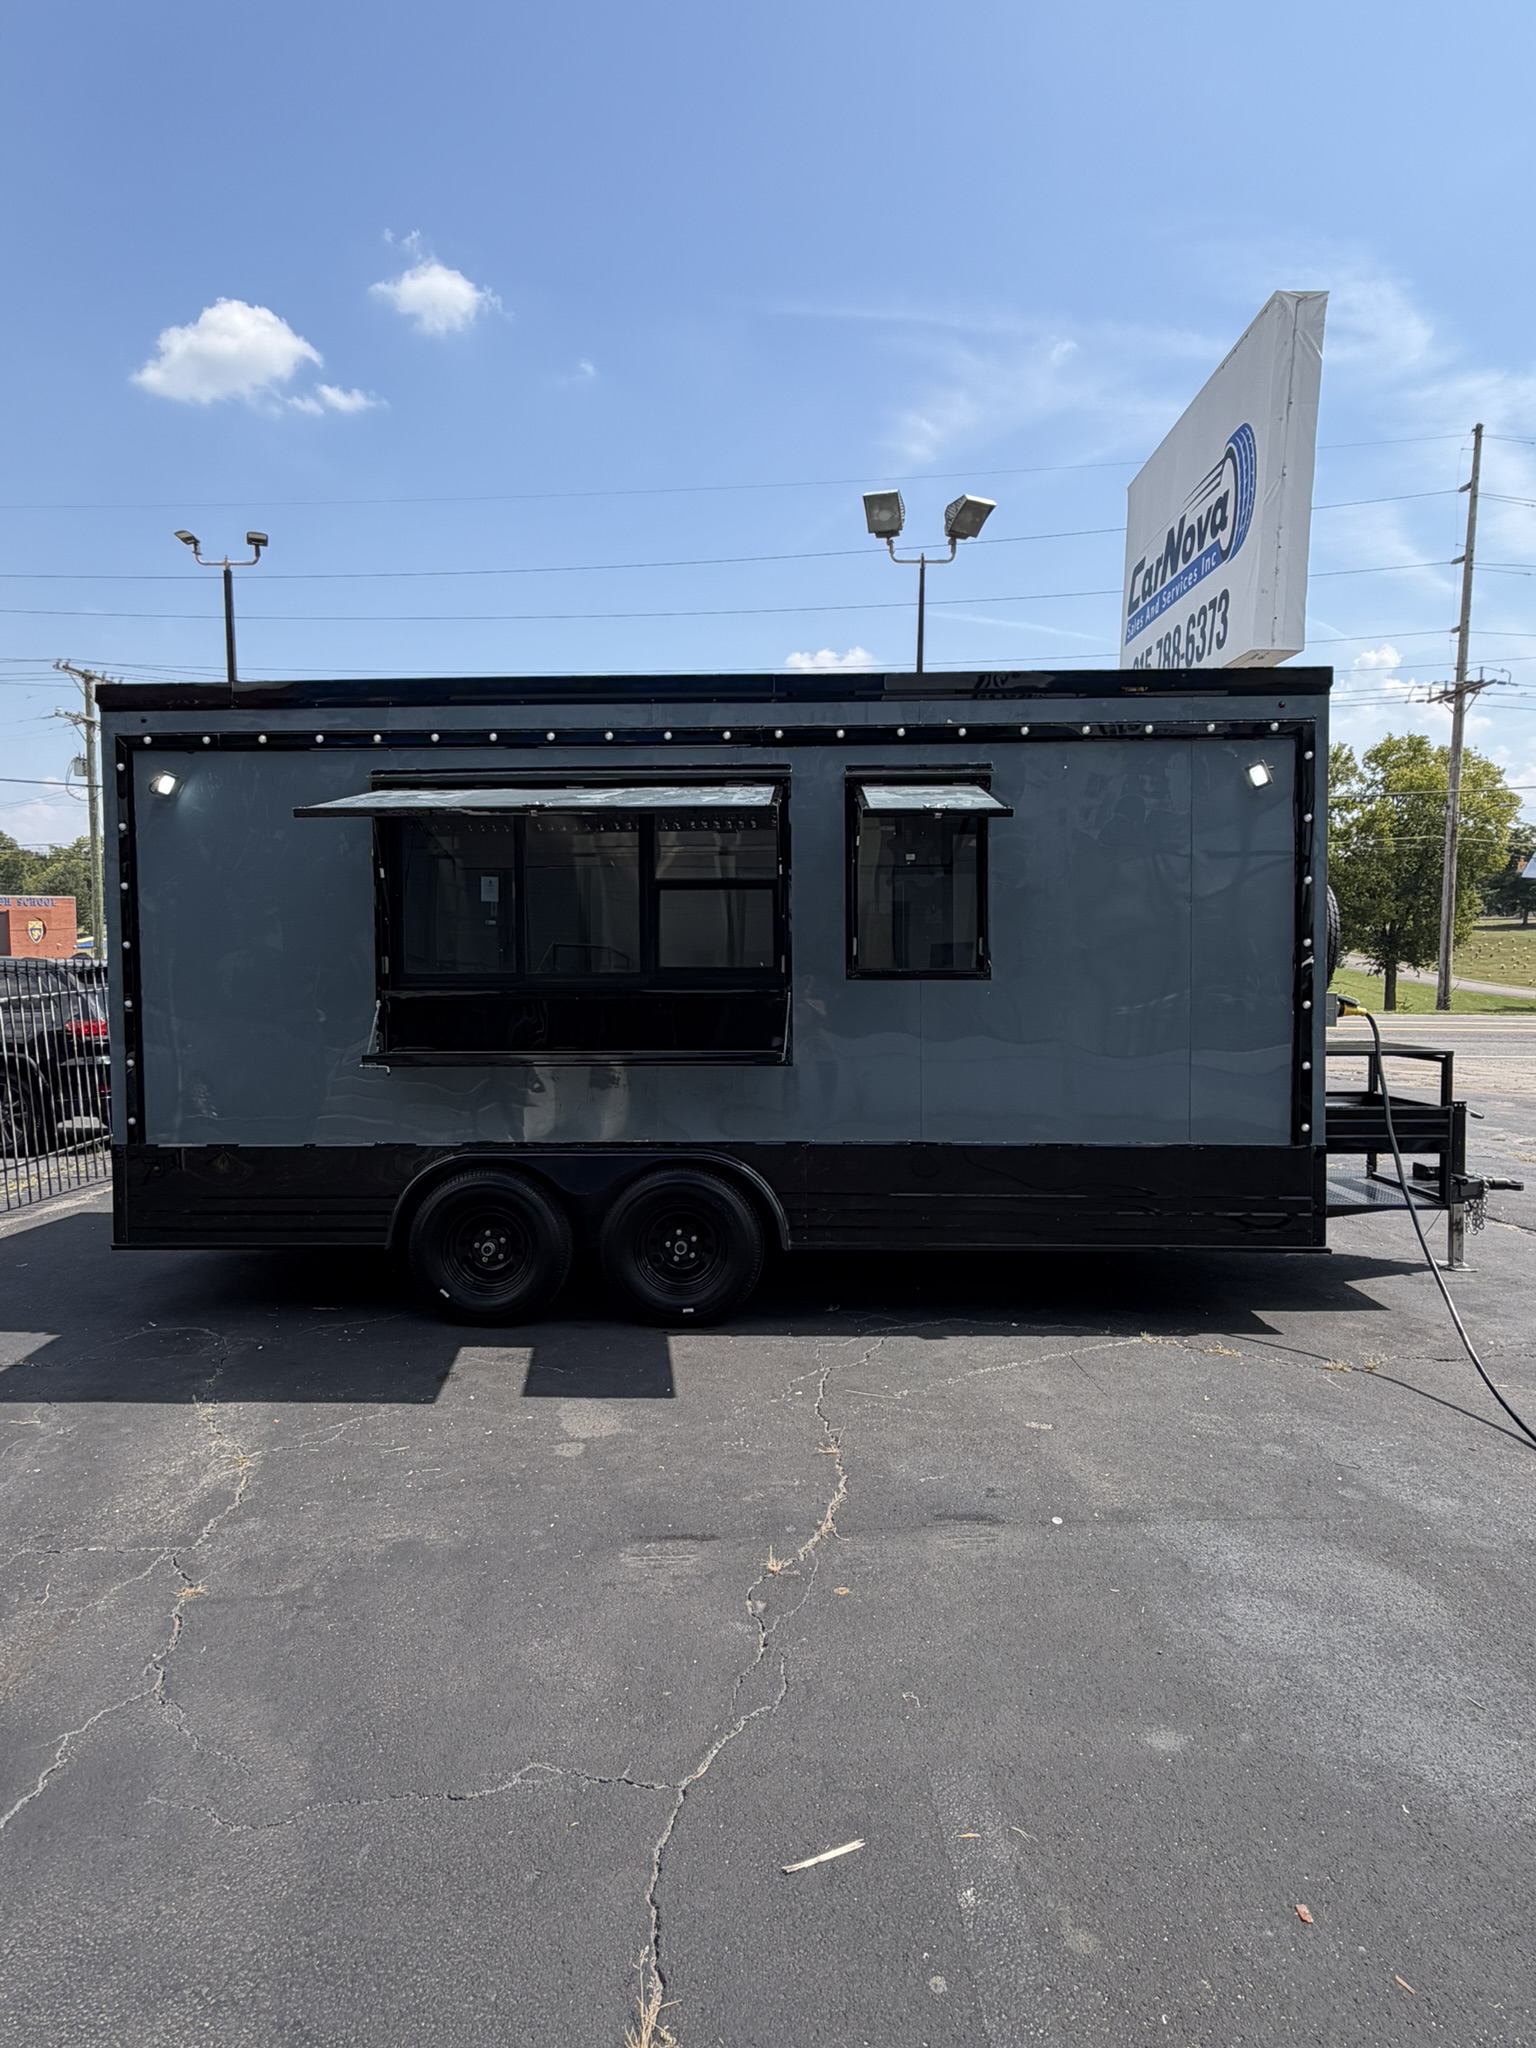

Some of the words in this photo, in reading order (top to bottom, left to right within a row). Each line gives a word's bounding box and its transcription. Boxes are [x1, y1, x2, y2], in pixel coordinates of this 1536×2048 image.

[1127, 614, 1144, 639] Sales
[1145, 595, 1160, 623] And
[1162, 568, 1198, 609] Services
[1201, 551, 1217, 576] Inc
[1128, 488, 1230, 617] CarNova
[1156, 588, 1230, 669] 788-6373
